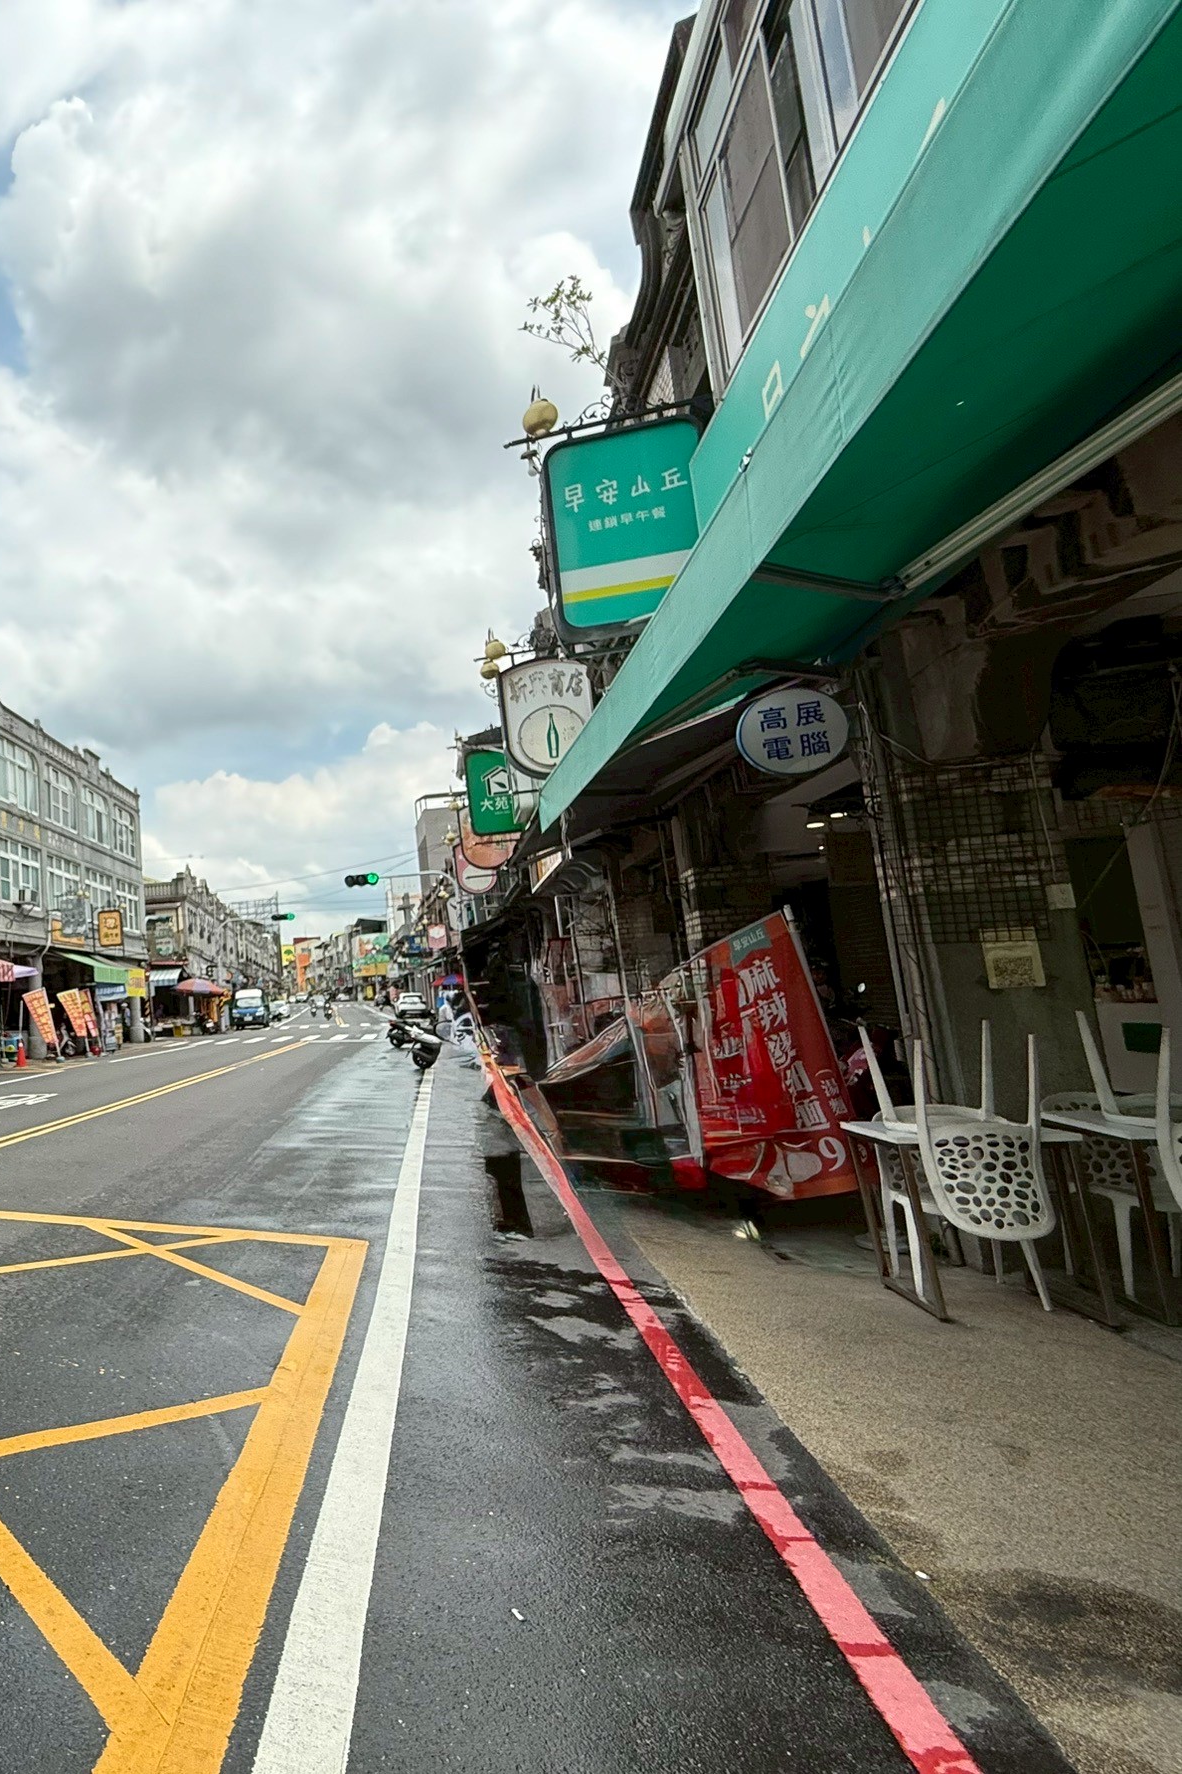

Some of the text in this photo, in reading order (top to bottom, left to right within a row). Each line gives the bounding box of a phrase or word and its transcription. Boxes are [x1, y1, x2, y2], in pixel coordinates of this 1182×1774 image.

[564, 467, 688, 513] 早安山丘
[588, 506, 666, 532] 連鎖早午餐
[758, 701, 826, 732] 高展
[763, 731, 831, 760] 電腦
[480, 796, 513, 812] 大苑
